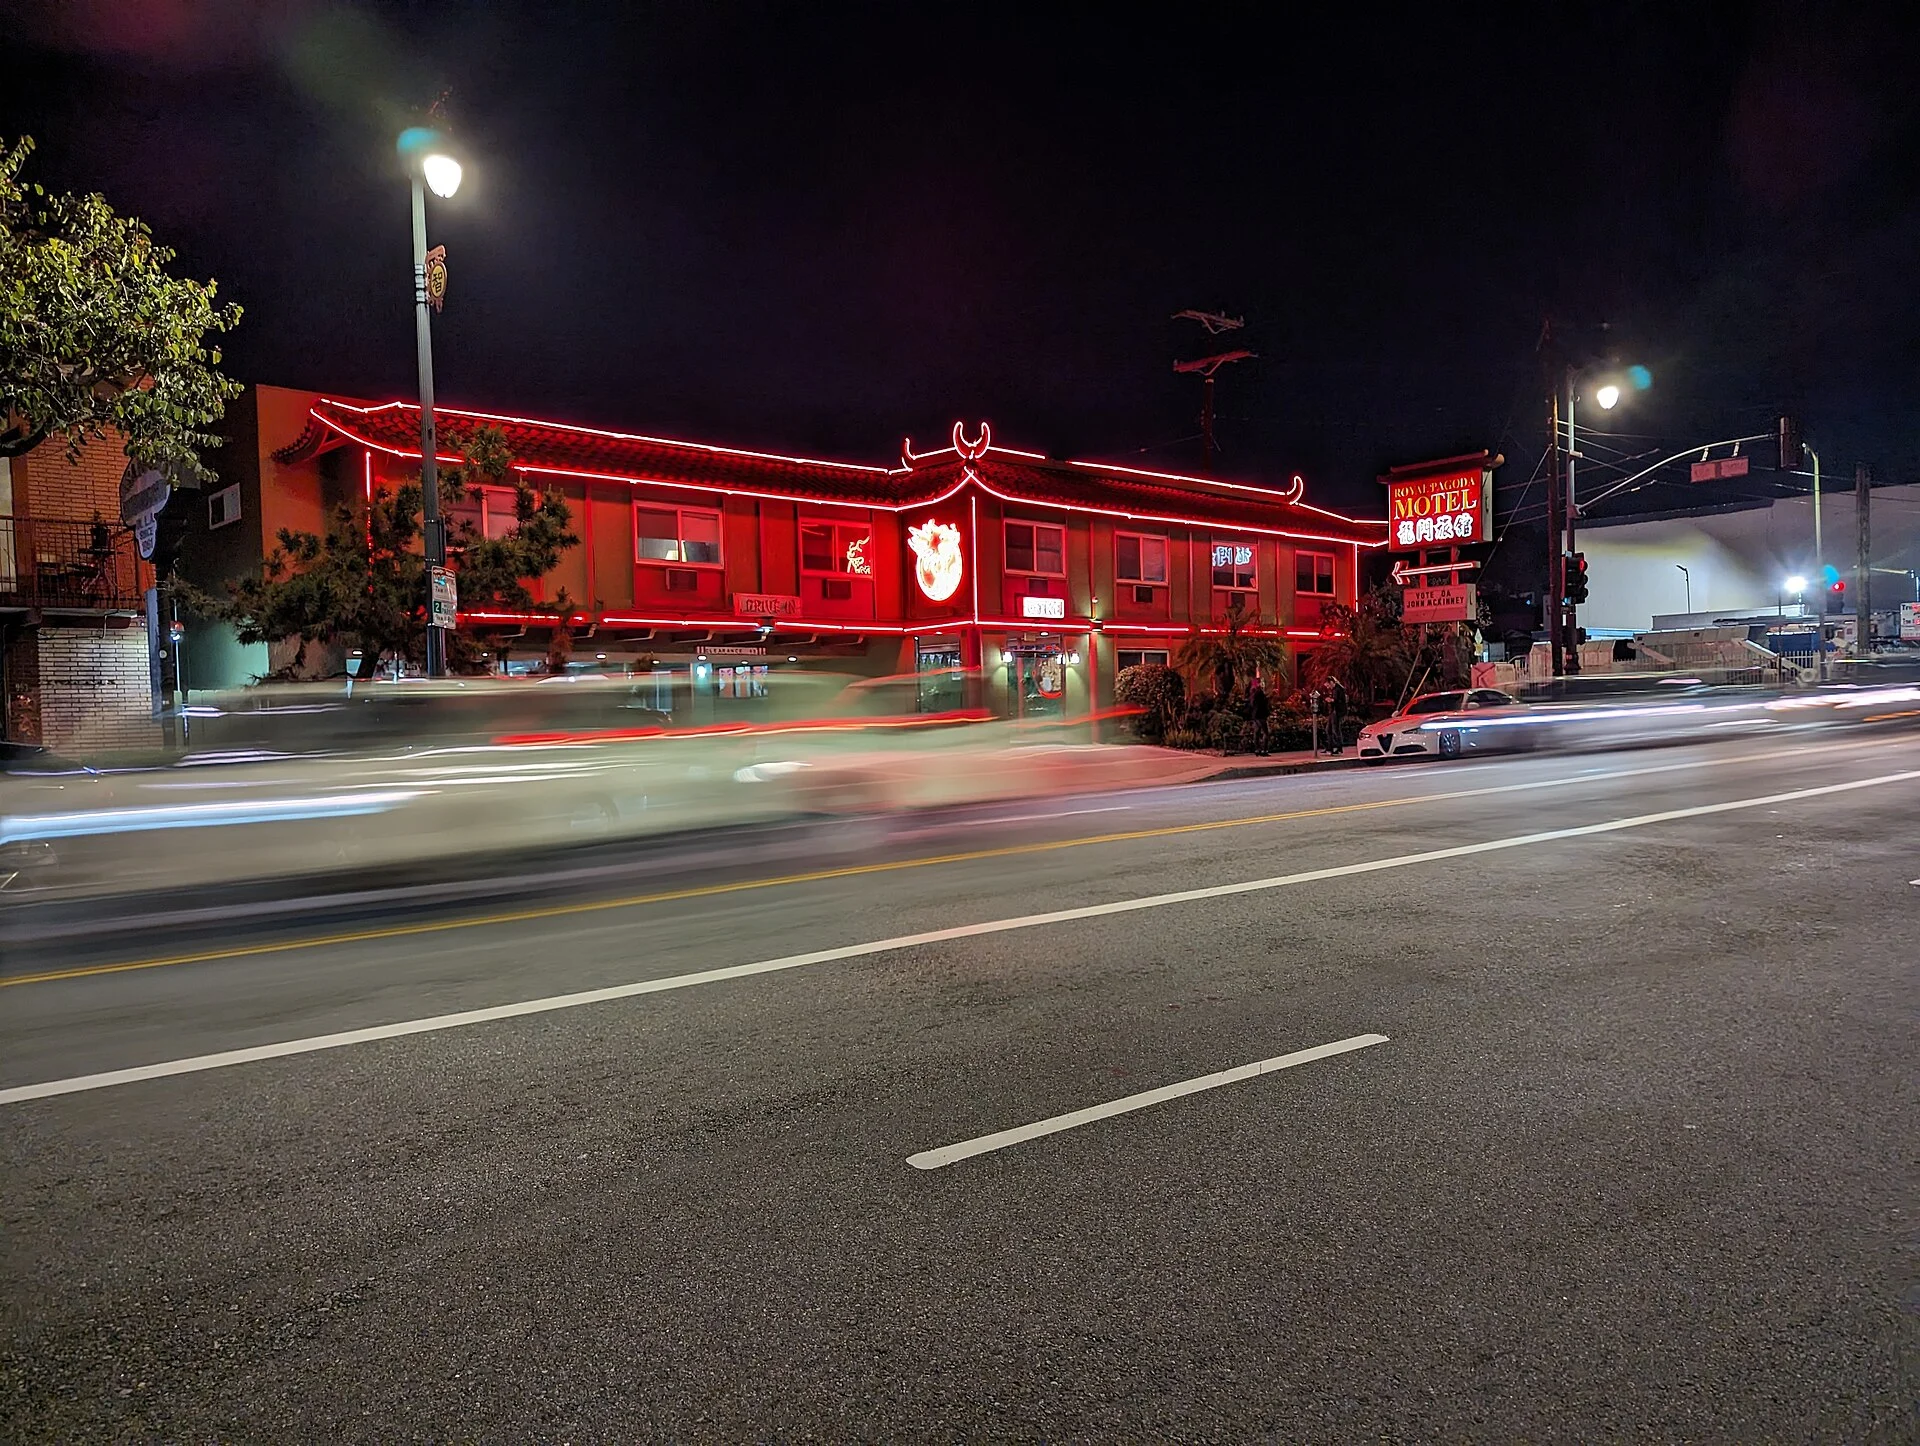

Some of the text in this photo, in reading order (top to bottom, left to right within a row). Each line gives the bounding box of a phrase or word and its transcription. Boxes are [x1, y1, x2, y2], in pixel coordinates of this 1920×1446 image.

[1394, 476, 1475, 498] ROYAL PAGODA
[1393, 488, 1477, 520] MOTEL
[1415, 591, 1434, 600] VOTE
[435, 602, 440, 612] 2
[1406, 596, 1464, 608] JOHN MCKINNEY
